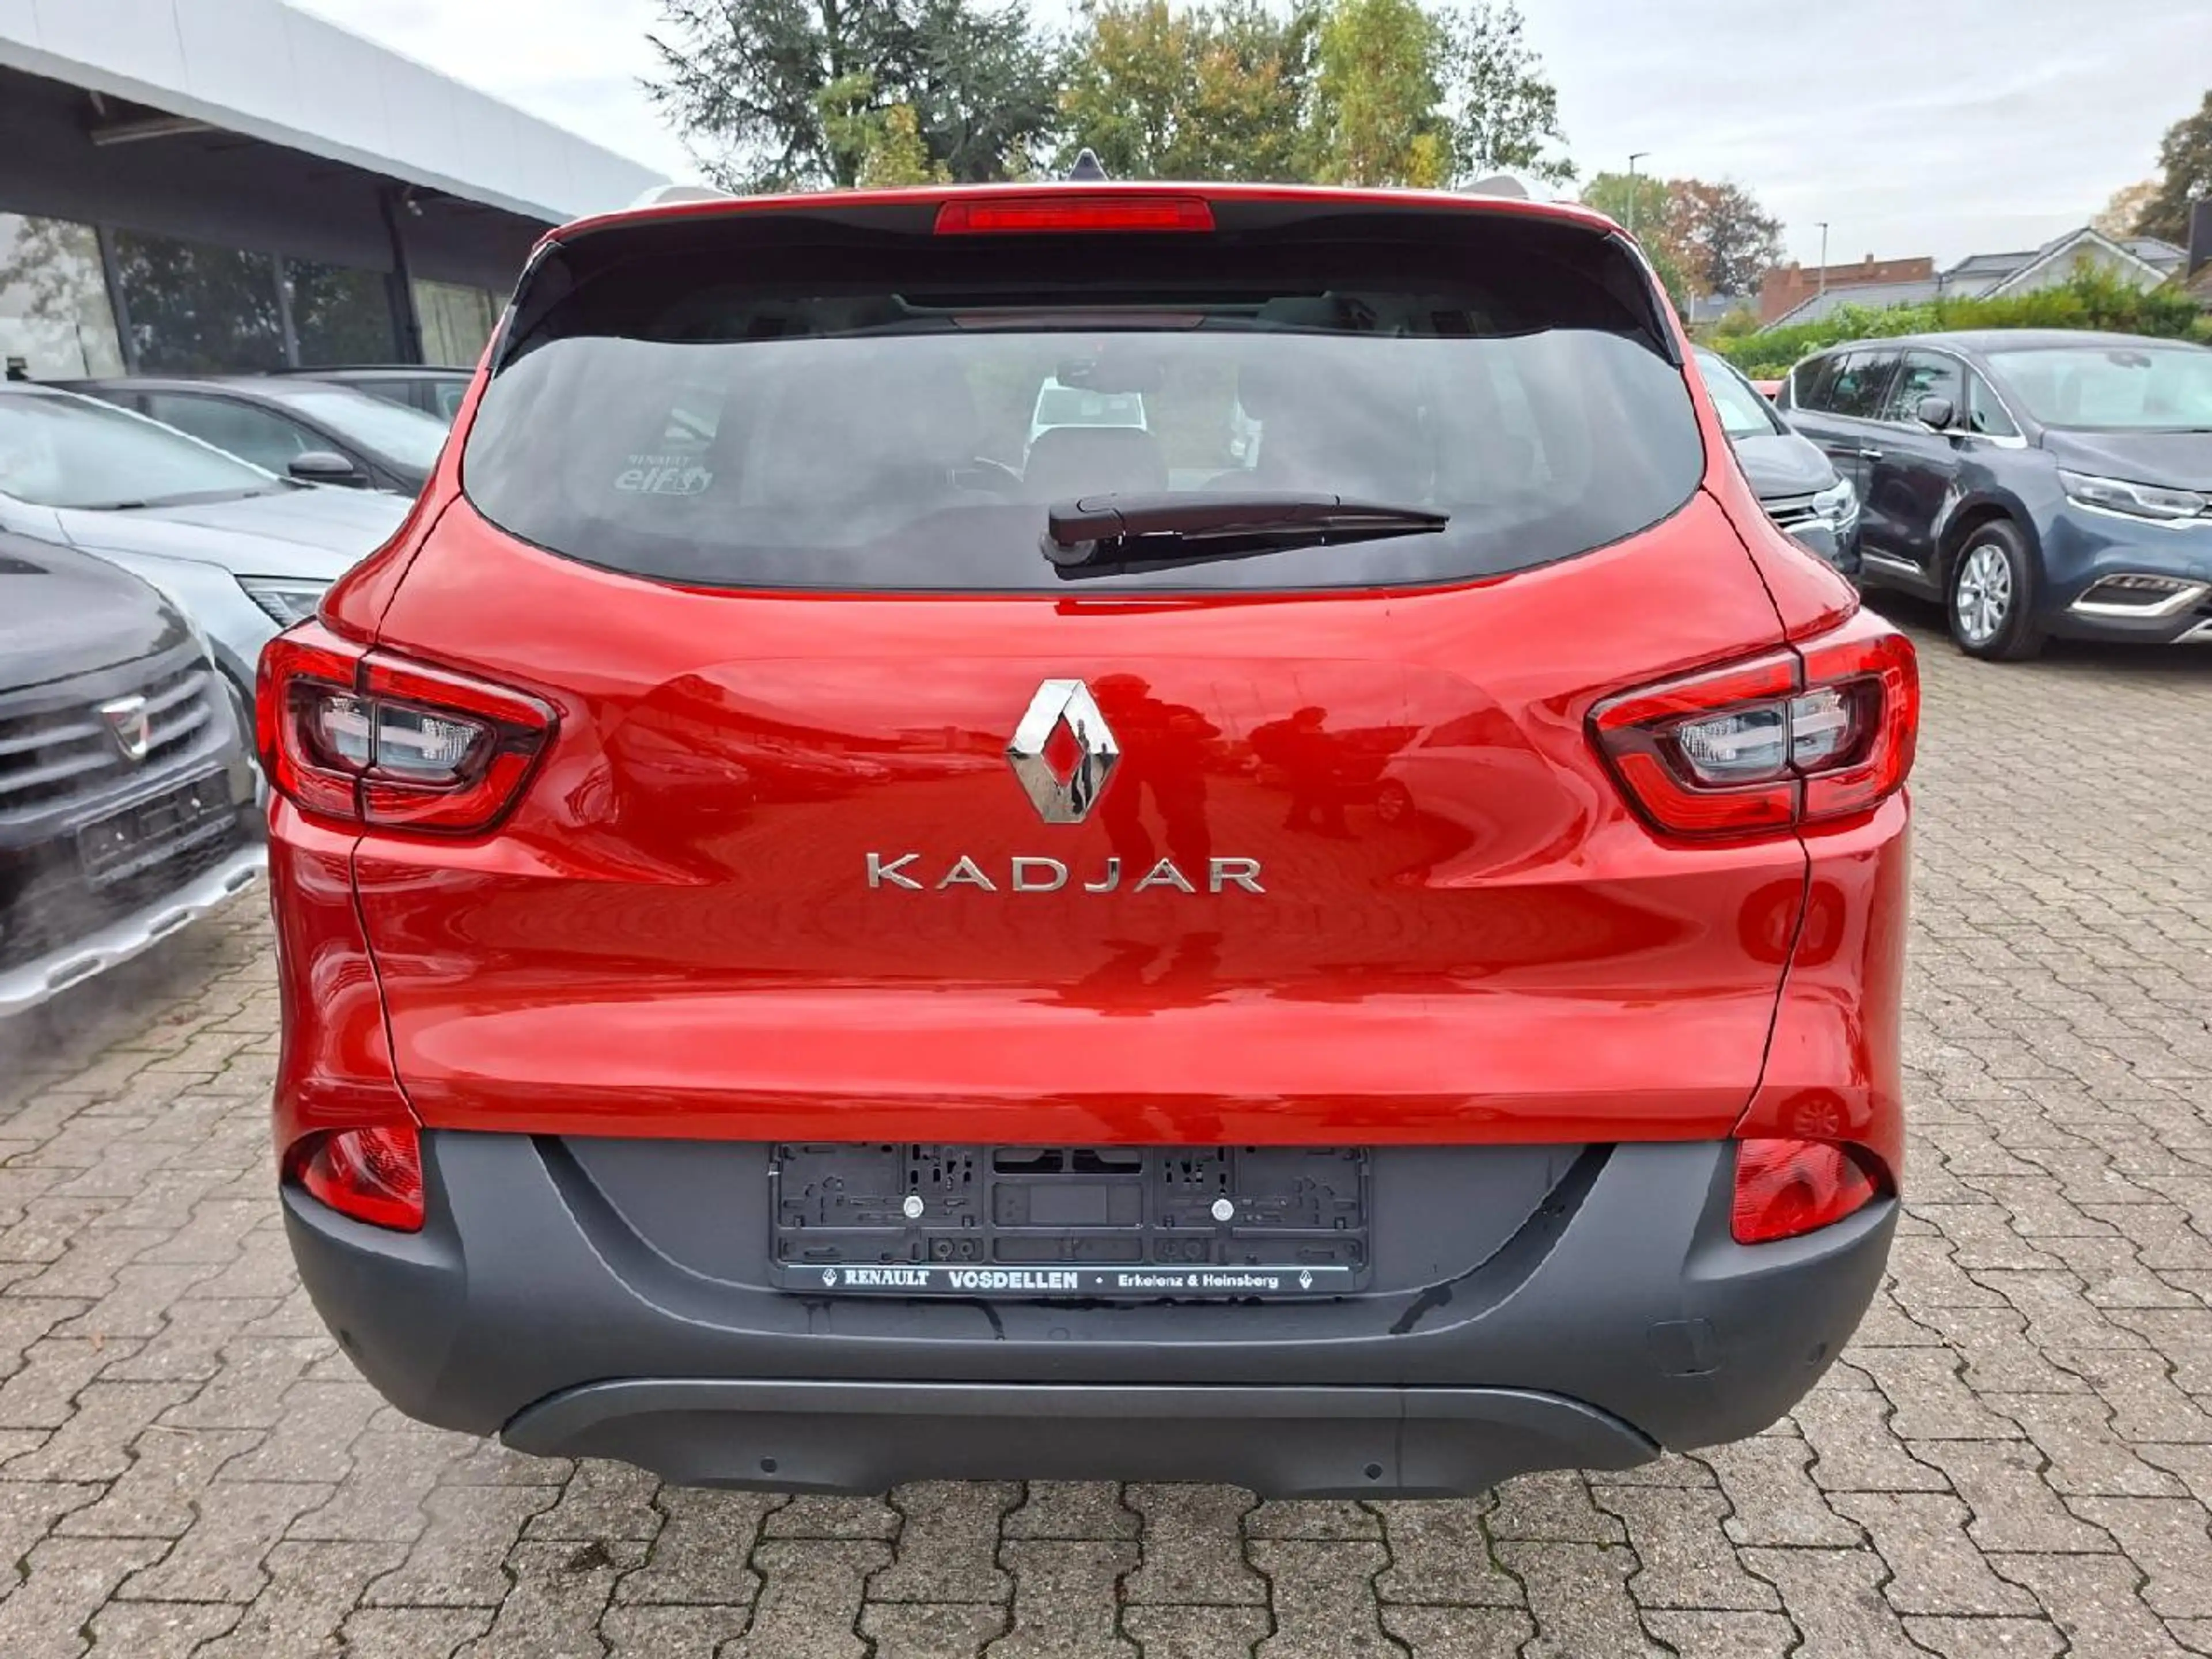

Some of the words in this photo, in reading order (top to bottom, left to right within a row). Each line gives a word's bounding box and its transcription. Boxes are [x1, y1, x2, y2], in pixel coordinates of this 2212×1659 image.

[866, 853, 1266, 893] KADJAR
[844, 1270, 930, 1286] RENAULT
[949, 1271, 1078, 1289] VOSDELLEN
[1118, 1274, 1183, 1287] Erkelenz
[1187, 1275, 1199, 1287] &
[1203, 1274, 1279, 1289] Heinsberg
